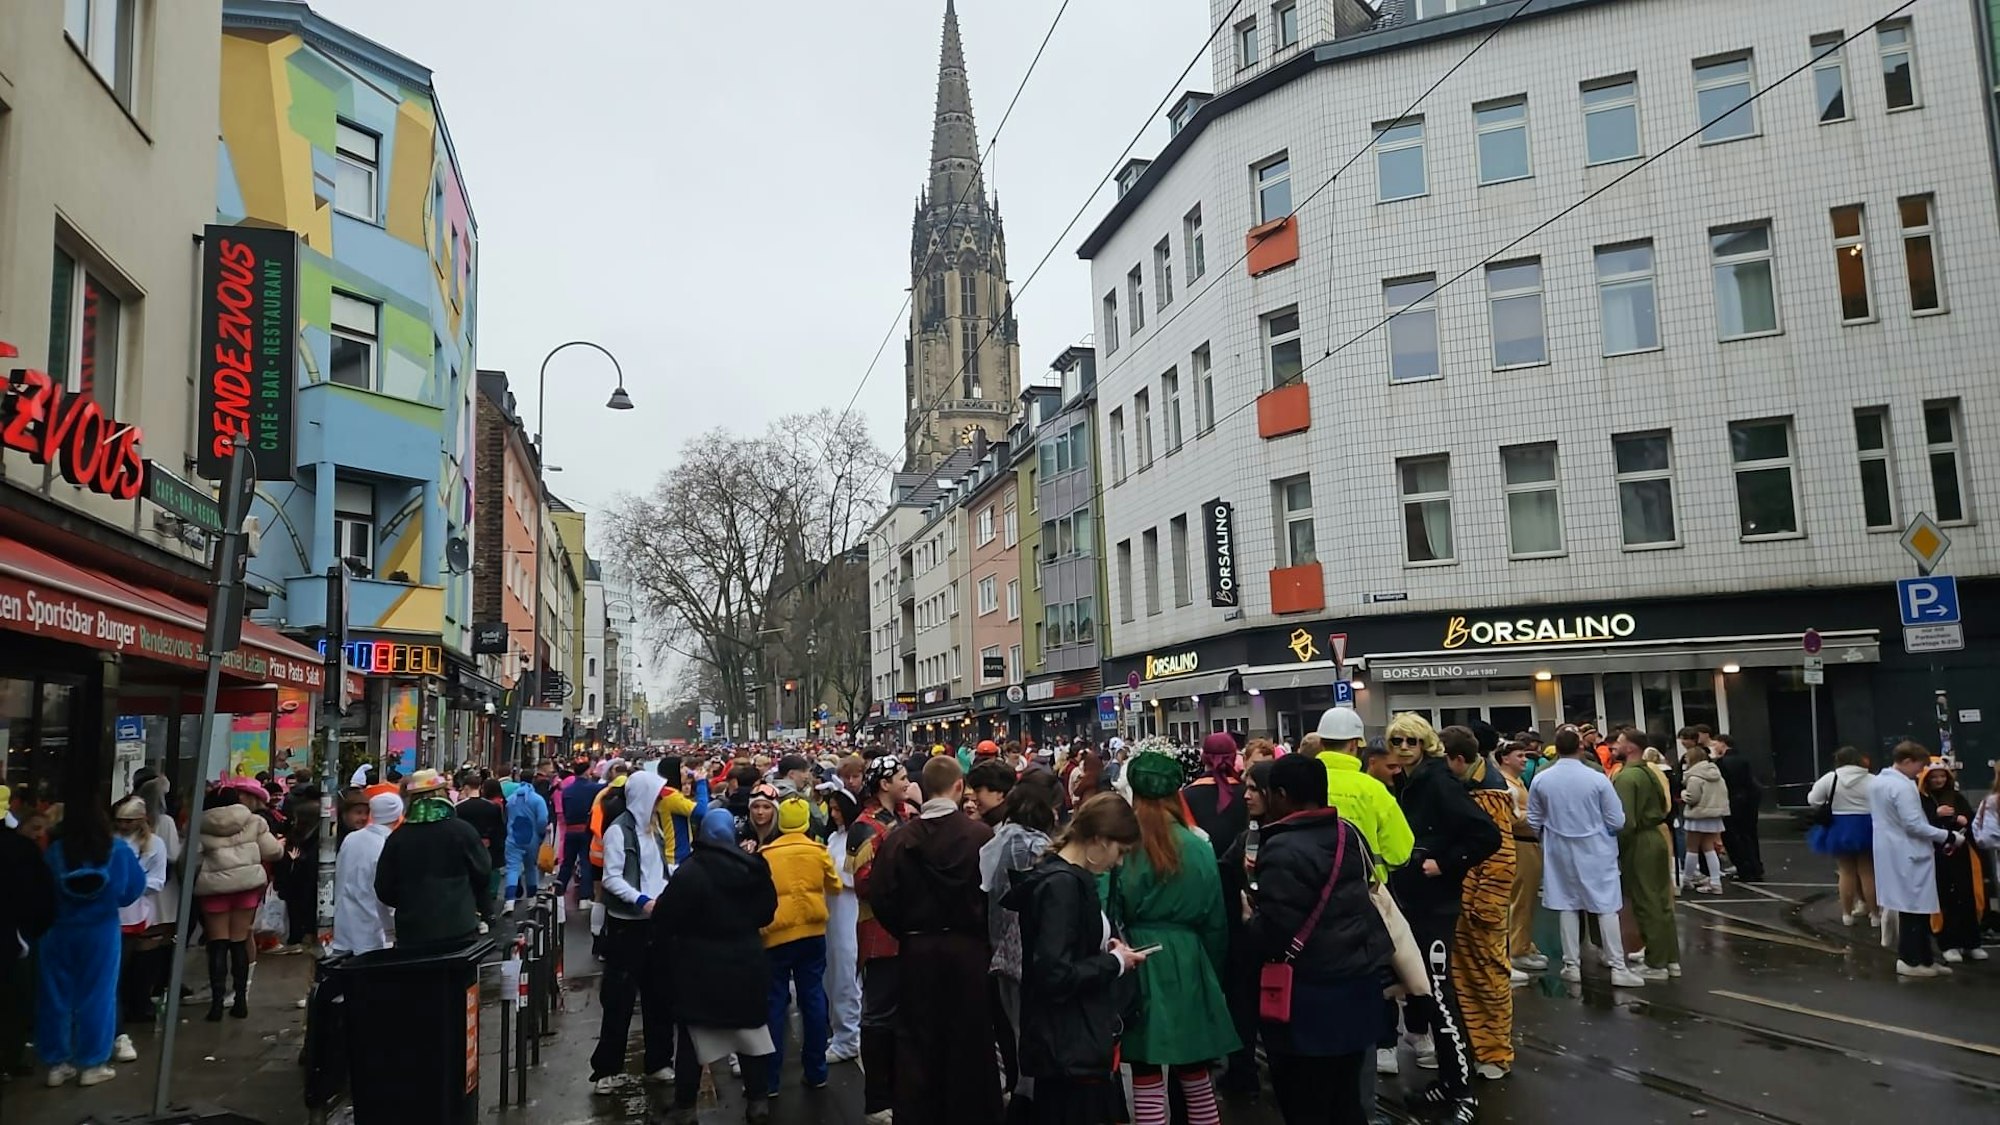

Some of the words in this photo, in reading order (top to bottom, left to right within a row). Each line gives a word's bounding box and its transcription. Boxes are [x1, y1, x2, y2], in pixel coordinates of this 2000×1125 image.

[263, 259, 282, 355] RESTAURANT
[213, 240, 254, 458] RENDEZVOUS
[262, 370, 280, 398] BAR
[0, 342, 144, 499] ZVOUS
[258, 413, 278, 450] CAFÉ
[1215, 506, 1233, 604] BORSALINO
[1907, 583, 1938, 618] P
[26, 590, 94, 636] Sportsbar
[97, 610, 136, 650] Burger
[269, 657, 286, 679] Pizza
[288, 661, 304, 682] Pasta
[1443, 613, 1636, 649] BORSALINO
[1145, 651, 1198, 680] BORSALINO
[1383, 666, 1463, 679] BORSALINO
[1338, 683, 1347, 699] P
[1429, 939, 1469, 1086] Champion
